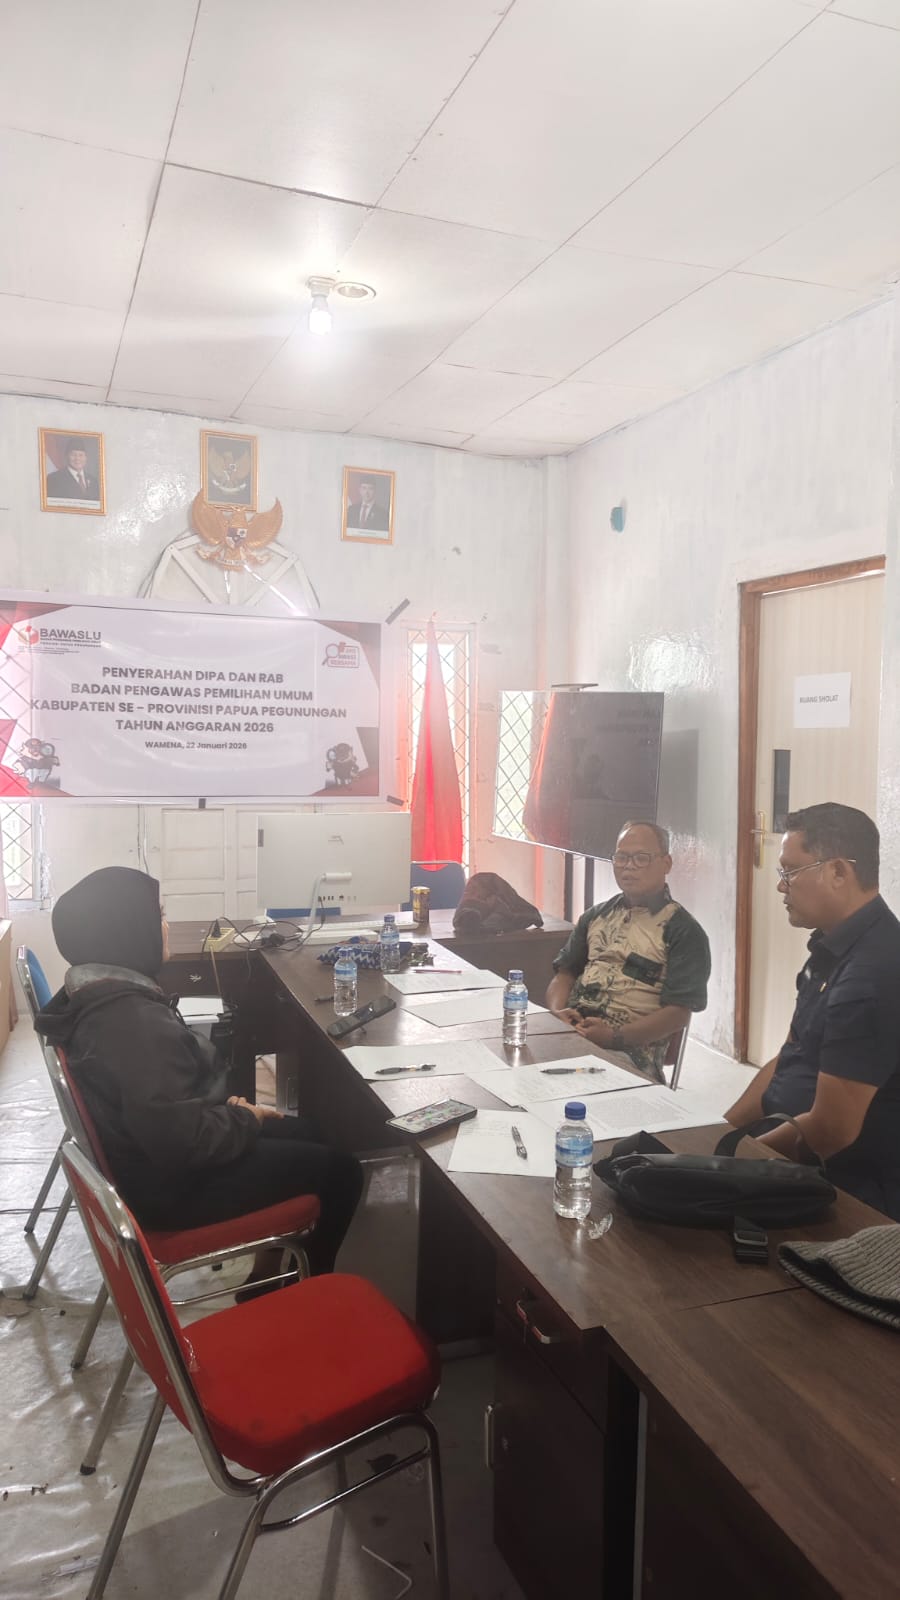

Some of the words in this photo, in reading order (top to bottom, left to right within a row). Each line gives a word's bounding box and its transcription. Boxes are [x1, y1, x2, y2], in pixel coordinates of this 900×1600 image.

[40, 628, 101, 640] BAWASLU
[102, 667, 192, 680] PENYERAHAN
[196, 671, 225, 682] DIPA
[229, 672, 256, 683] DAN
[259, 673, 284, 684] RAB
[71, 683, 121, 695] BADAN
[124, 685, 201, 698] PENGAWAS
[204, 688, 271, 700] PEMILIHAN
[274, 690, 313, 701] UMUM
[31, 699, 115, 712] KABUPATEN
[118, 702, 134, 713] SE
[216, 705, 259, 716] PAPUA
[261, 706, 347, 718] PEGUNUNGAN
[115, 719, 163, 731] TAHUN
[165, 720, 241, 732] ANGGARAN
[244, 722, 274, 733] 2026
[144, 741, 185, 750] WAMENA,
[197, 742, 227, 750] Januari
[229, 742, 247, 750] 2026
